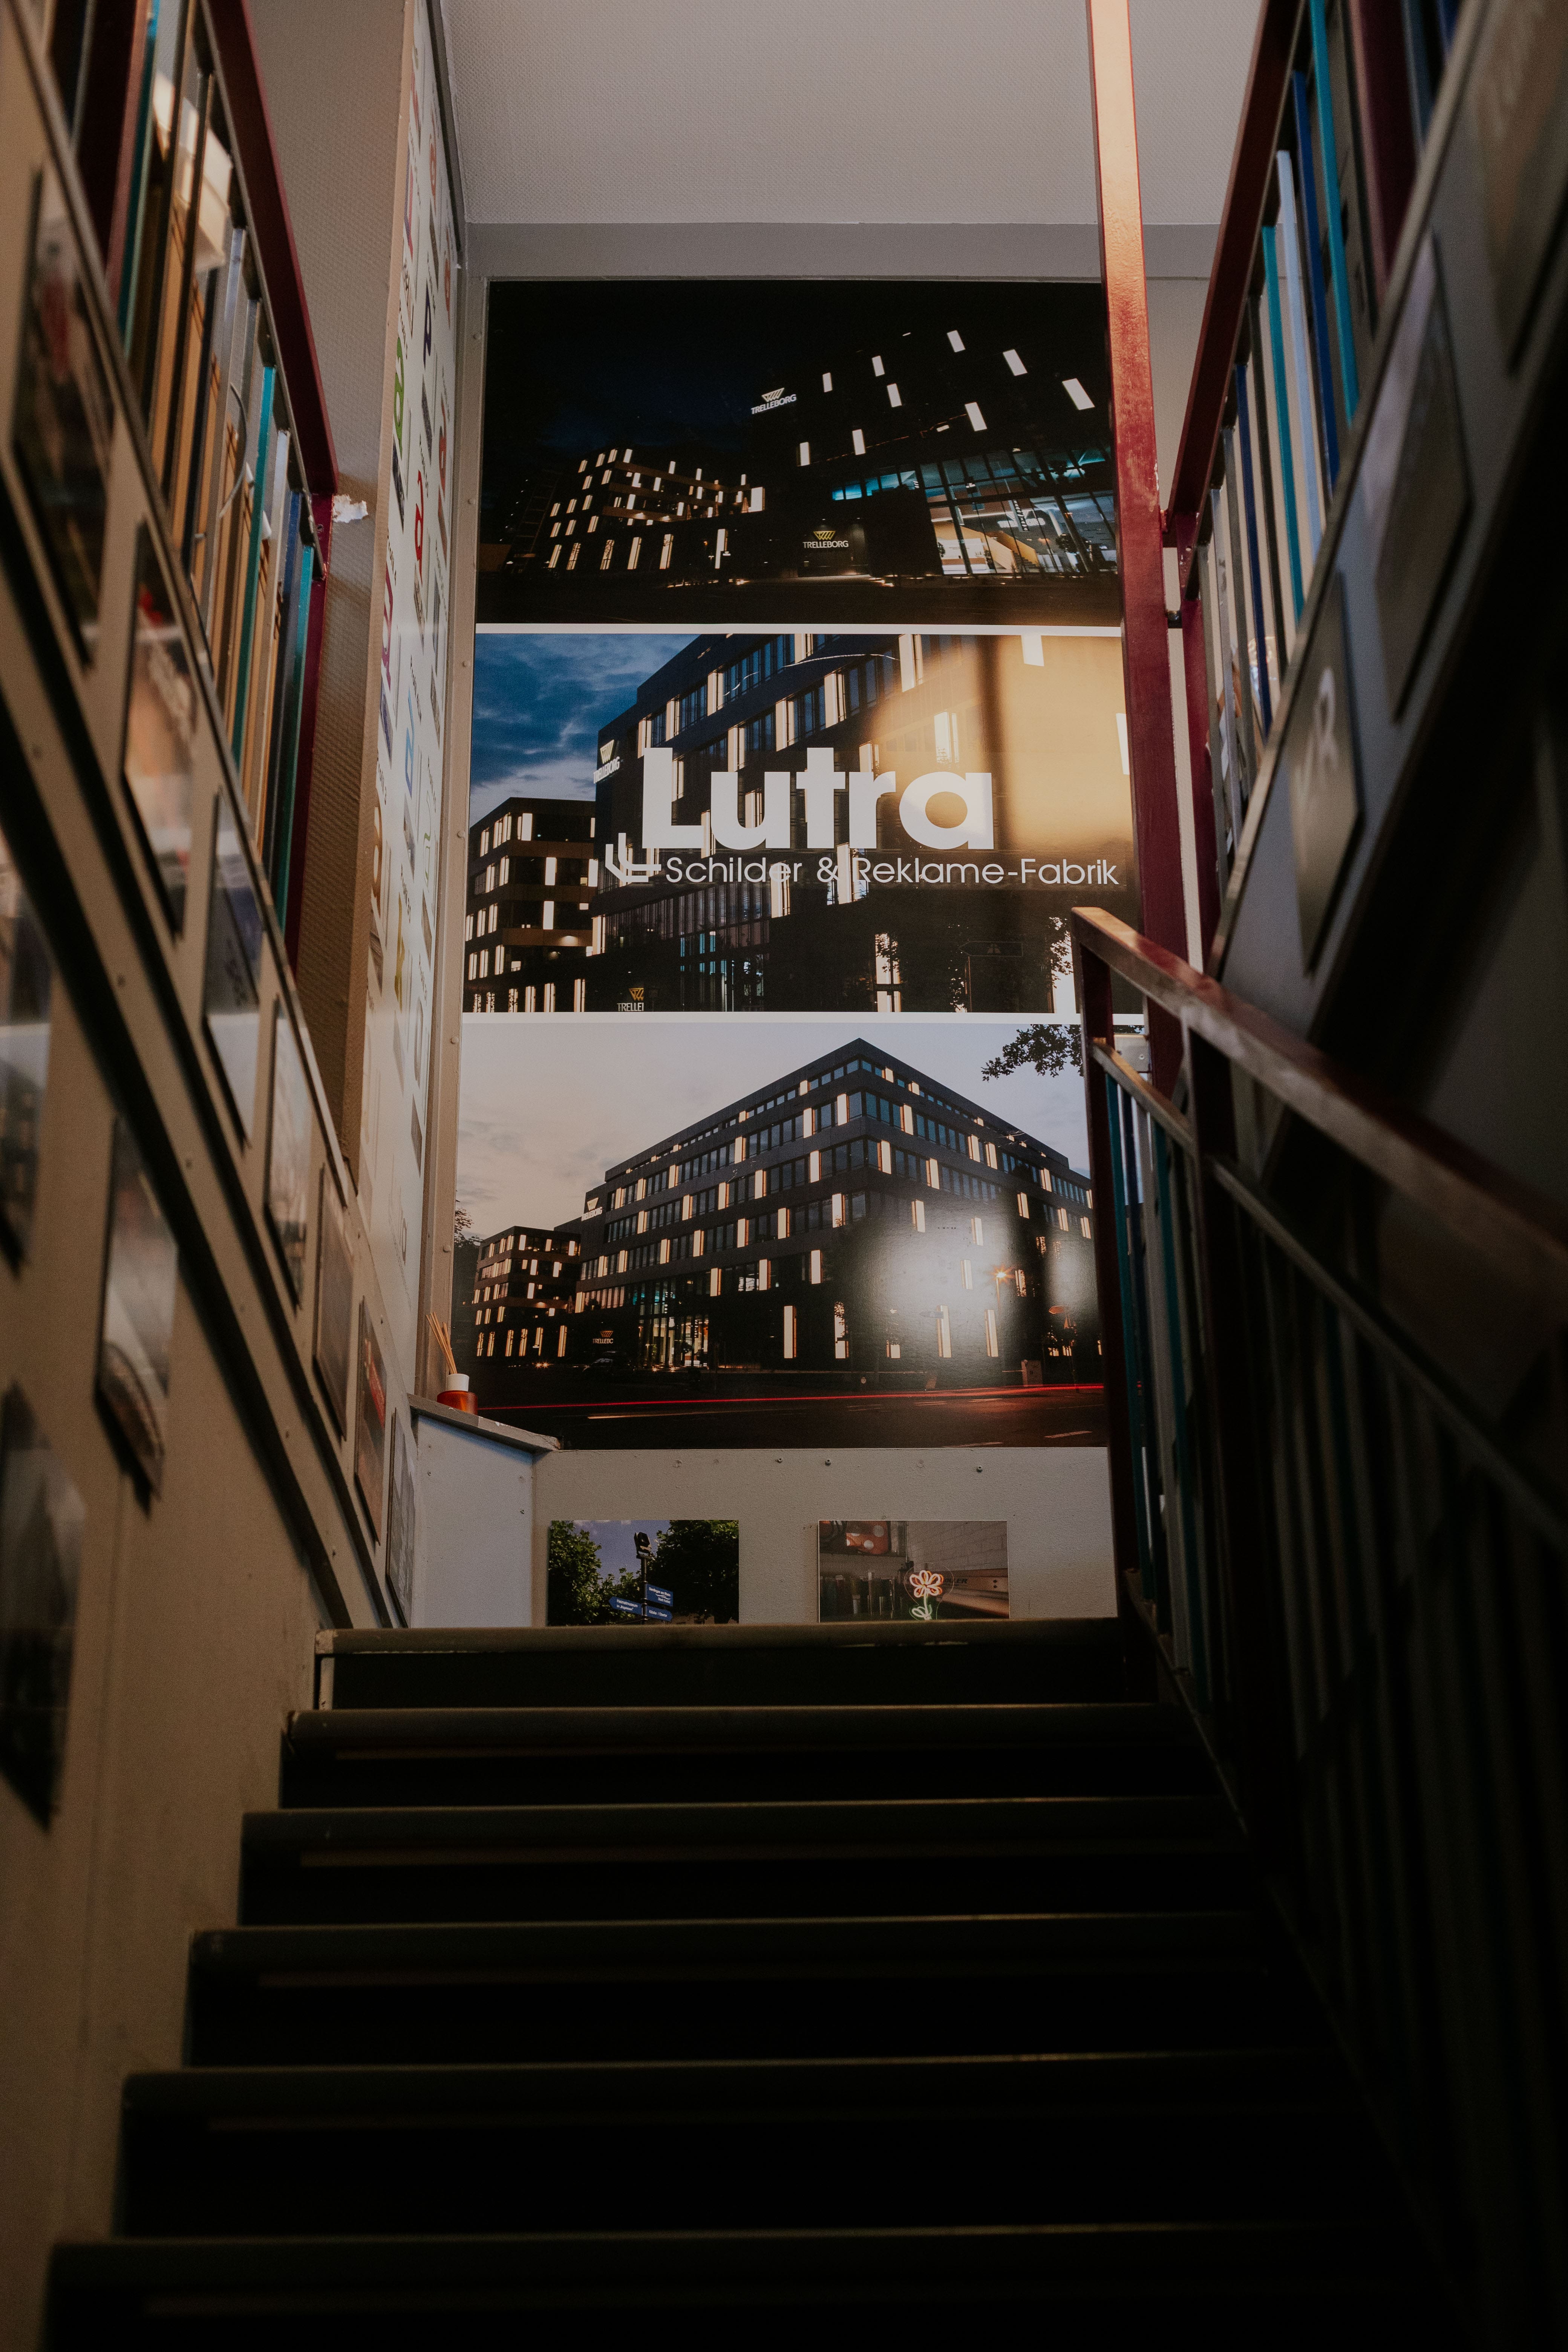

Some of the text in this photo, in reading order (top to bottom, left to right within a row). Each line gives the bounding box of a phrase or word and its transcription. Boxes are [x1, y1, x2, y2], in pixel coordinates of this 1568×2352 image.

[751, 394, 797, 415] TRELLEBORG
[802, 540, 849, 548] TRELLEBORG
[594, 756, 620, 784] TRELLEBORG
[642, 747, 994, 850] Lutra
[666, 857, 1119, 885] Schilder & Reklame-Fabrik
